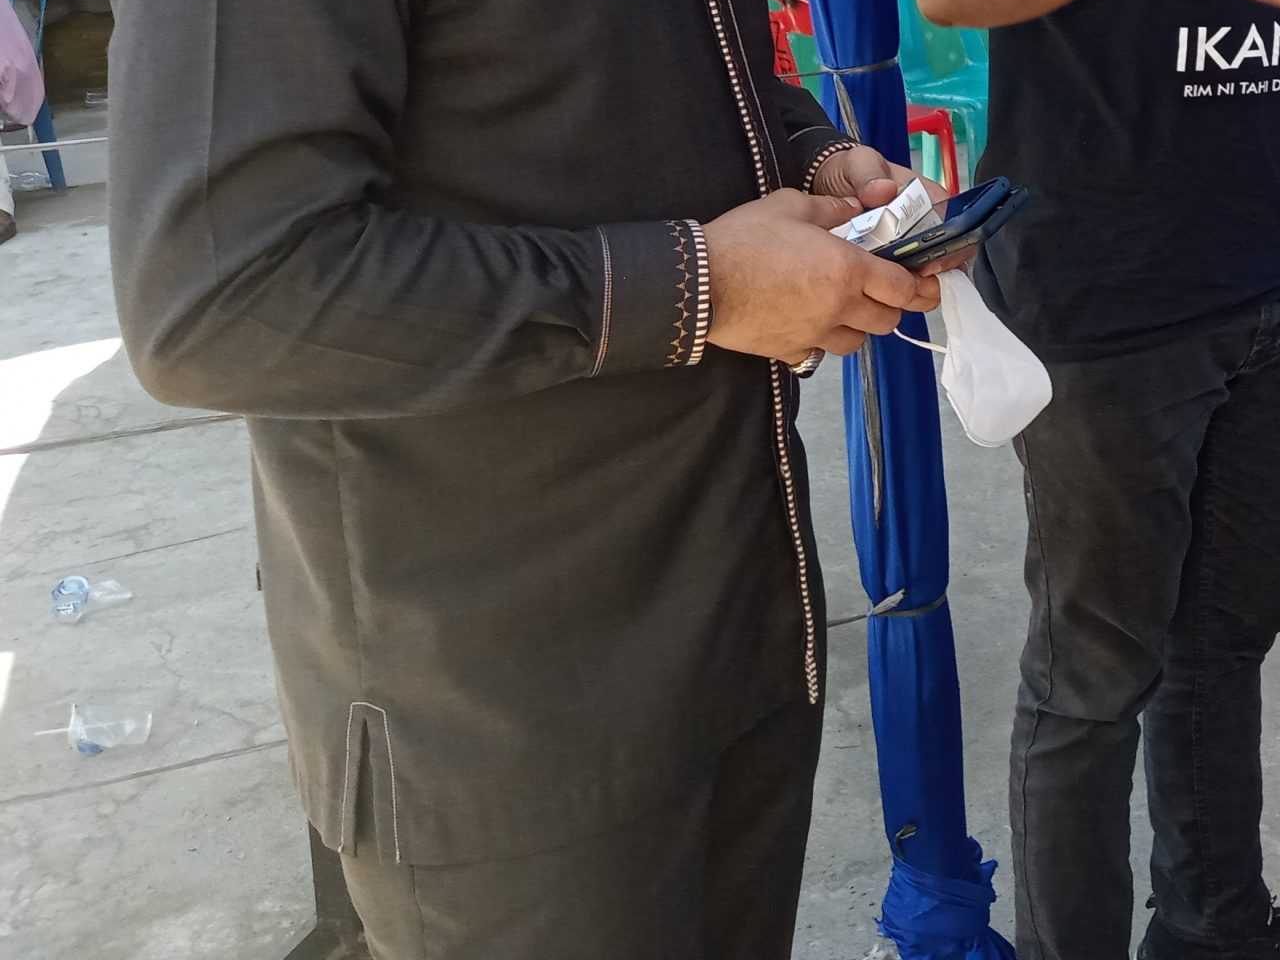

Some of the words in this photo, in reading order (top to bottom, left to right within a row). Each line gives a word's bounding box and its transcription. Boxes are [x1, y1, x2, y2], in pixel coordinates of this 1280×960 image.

[1183, 84, 1212, 98] RIM
[1217, 82, 1235, 96] NI
[1239, 80, 1269, 94] TAHI
